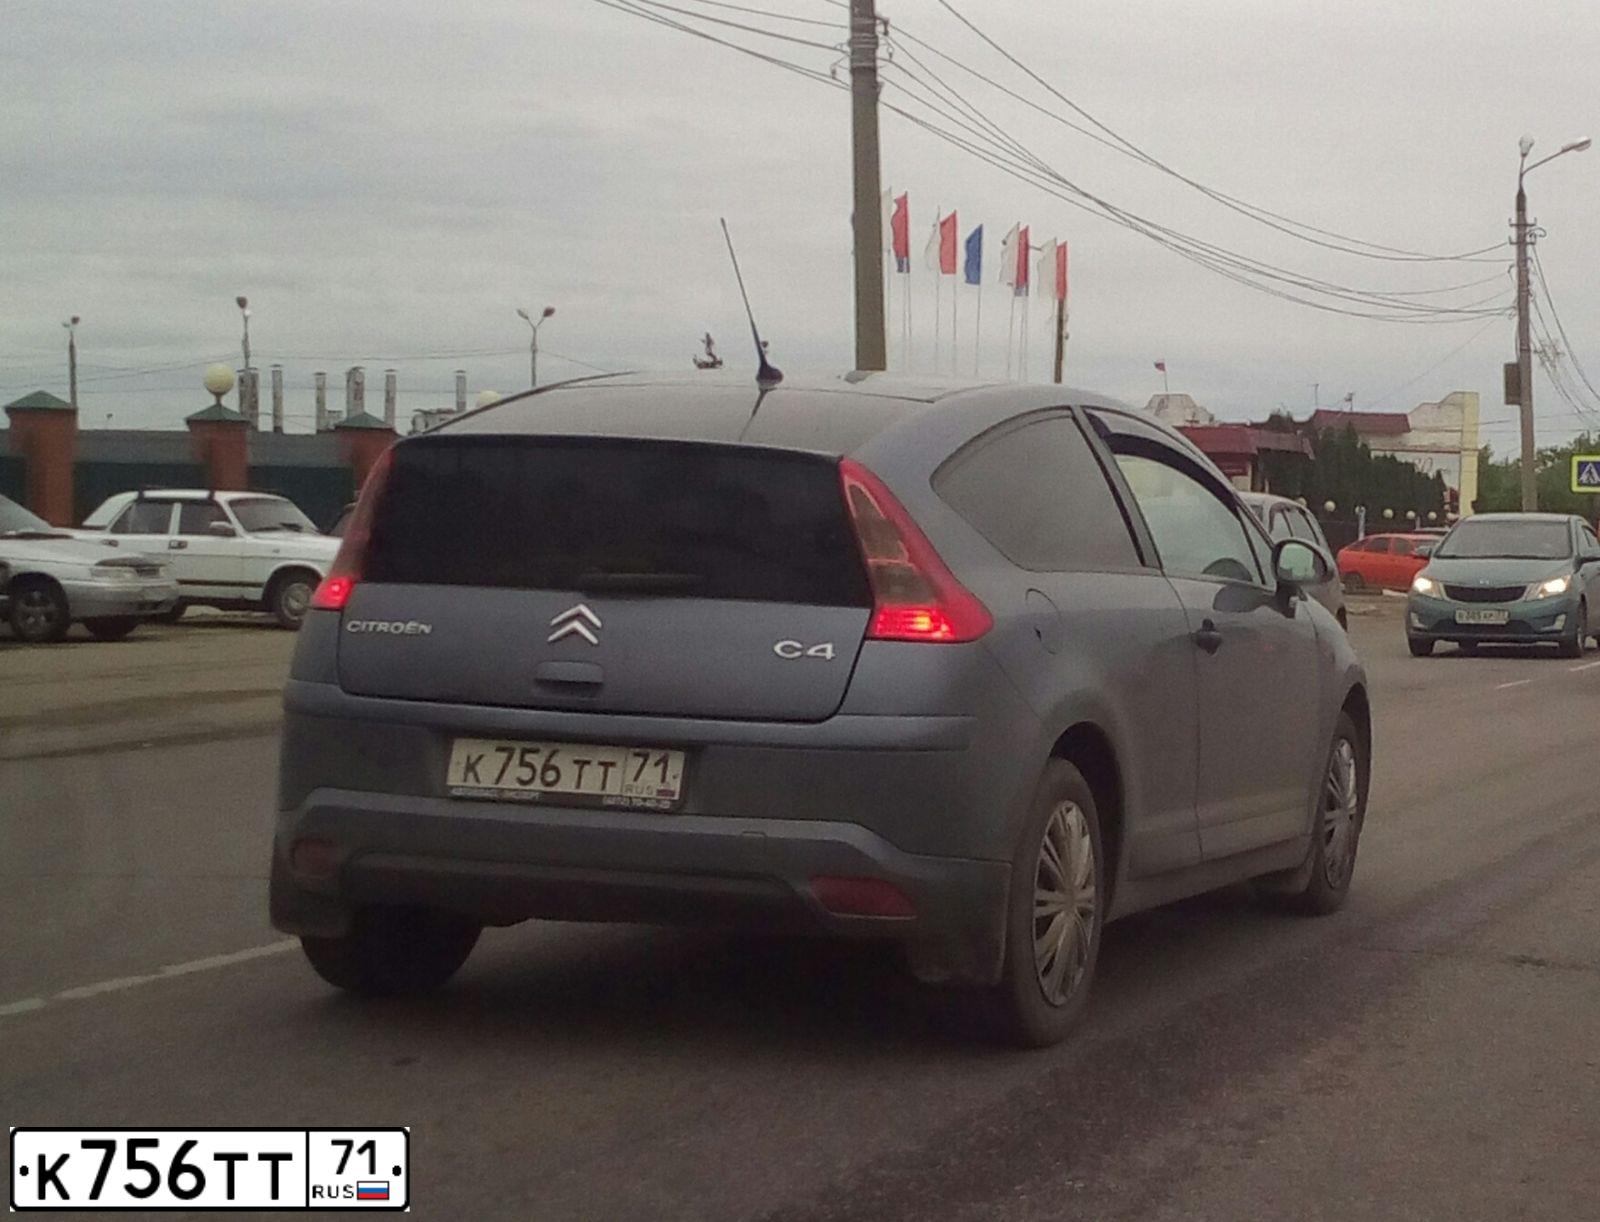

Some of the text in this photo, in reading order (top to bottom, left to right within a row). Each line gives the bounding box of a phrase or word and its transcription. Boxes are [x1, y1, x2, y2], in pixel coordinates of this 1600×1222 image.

[773, 640, 836, 660] C4
[633, 751, 670, 784] 71
[624, 783, 654, 796] RUS
